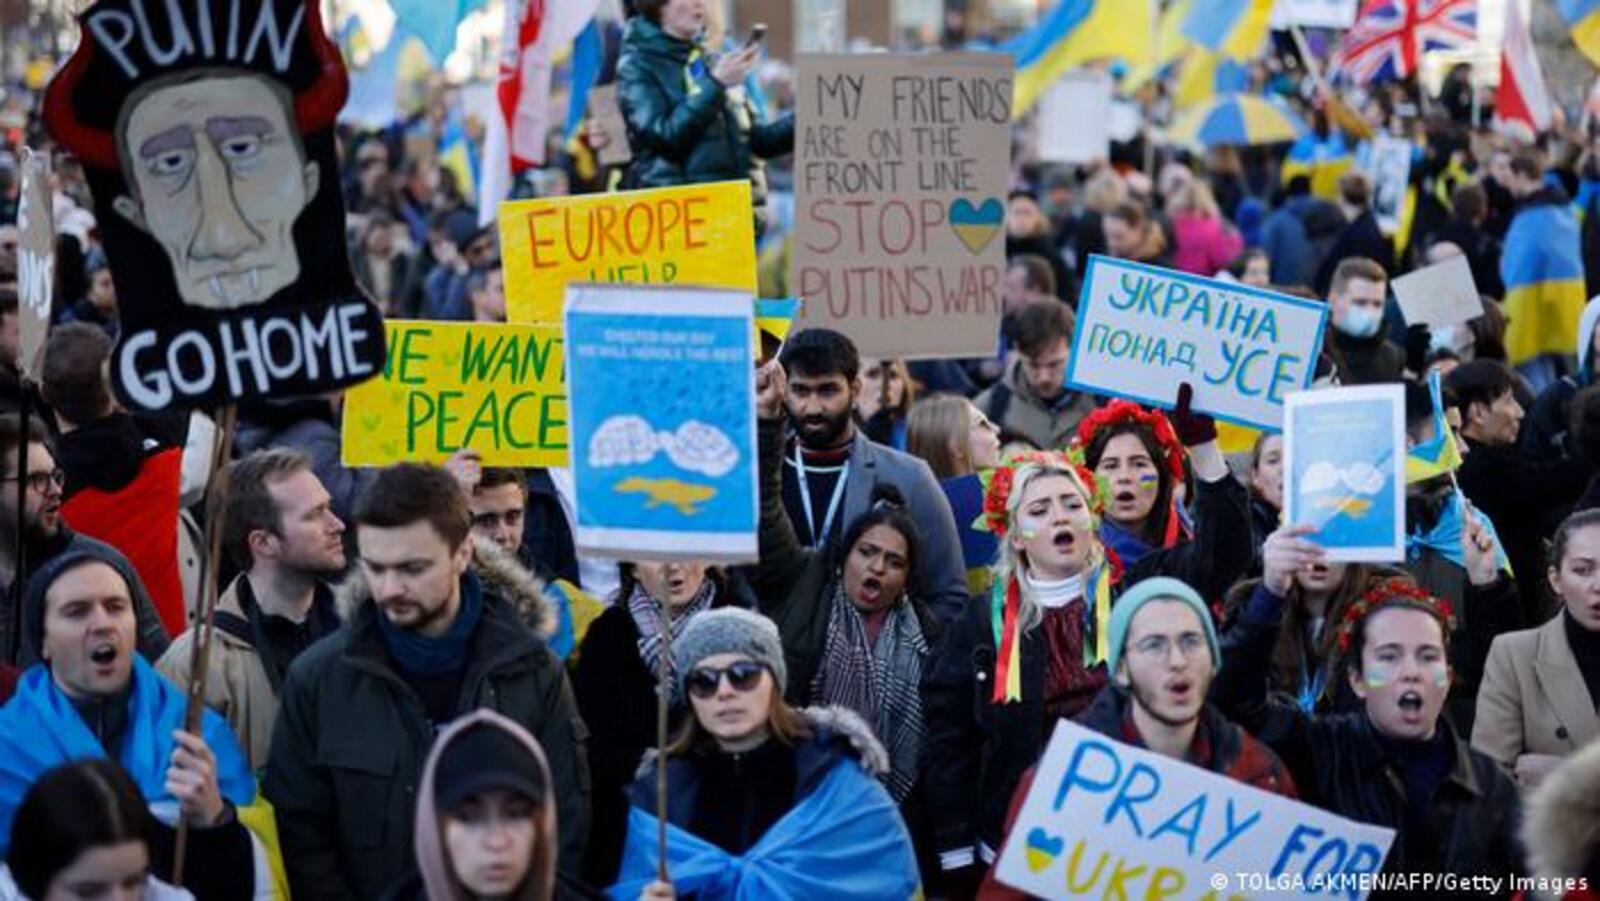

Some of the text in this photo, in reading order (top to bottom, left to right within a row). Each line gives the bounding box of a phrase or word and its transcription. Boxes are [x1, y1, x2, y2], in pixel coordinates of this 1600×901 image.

[817, 74, 1012, 123] MY FRIENDS
[804, 125, 963, 158] ARE ON THE
[806, 158, 979, 193] FRONT LINE
[527, 198, 709, 268] EUROPE
[805, 199, 945, 255] STOP
[801, 264, 1000, 320] PUTINS WAR
[1108, 273, 1277, 343] УКРАЇНА
[219, 303, 373, 397] HOME
[1088, 323, 1301, 403] ПОНАД УСЕ
[407, 390, 567, 452] PEACE
[1053, 740, 1381, 901] PRAY FOR
